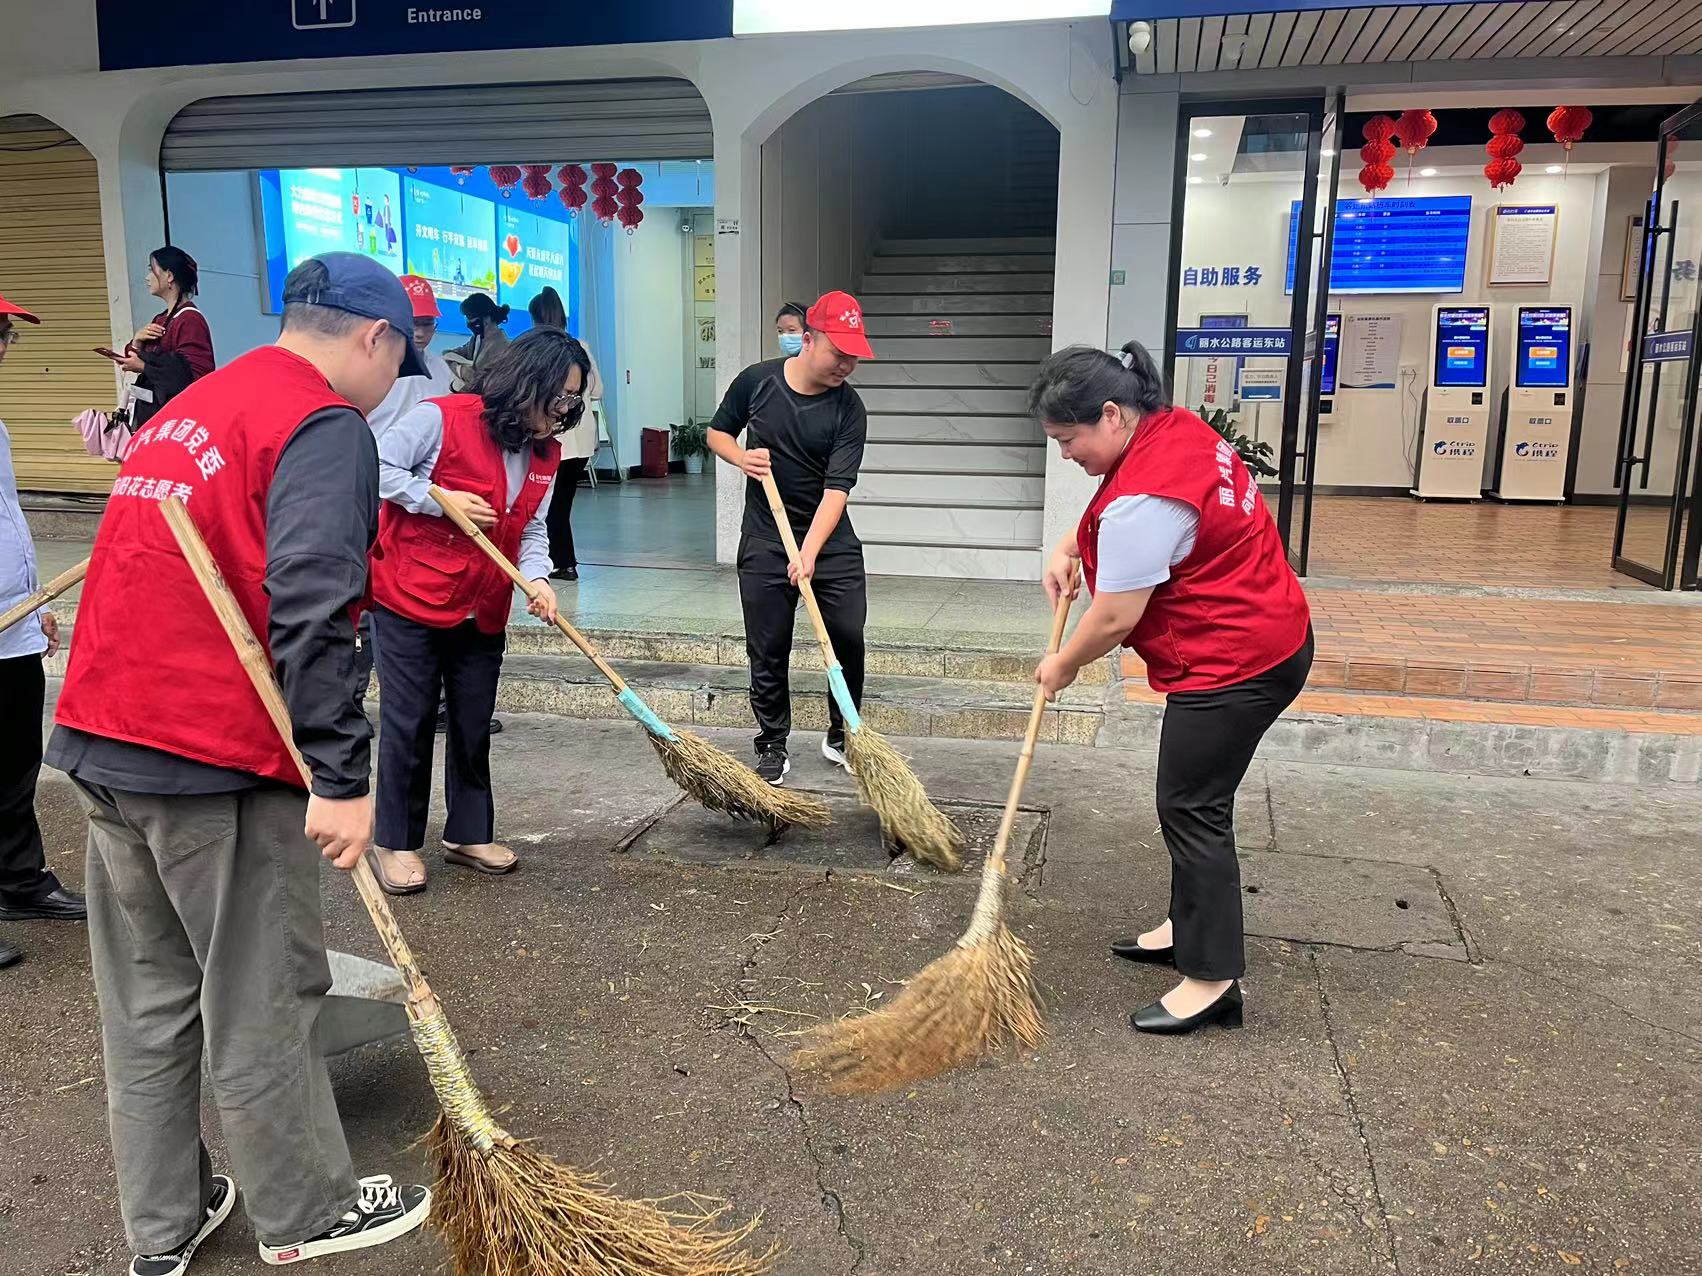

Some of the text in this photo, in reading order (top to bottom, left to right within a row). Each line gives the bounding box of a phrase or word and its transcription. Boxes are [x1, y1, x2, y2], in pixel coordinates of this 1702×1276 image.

[407, 8, 482, 23] Entrance
[1183, 266, 1262, 287] 自助服务
[1199, 337, 1286, 349] 丽水公路客运东站
[123, 418, 226, 482] 汽集团党委
